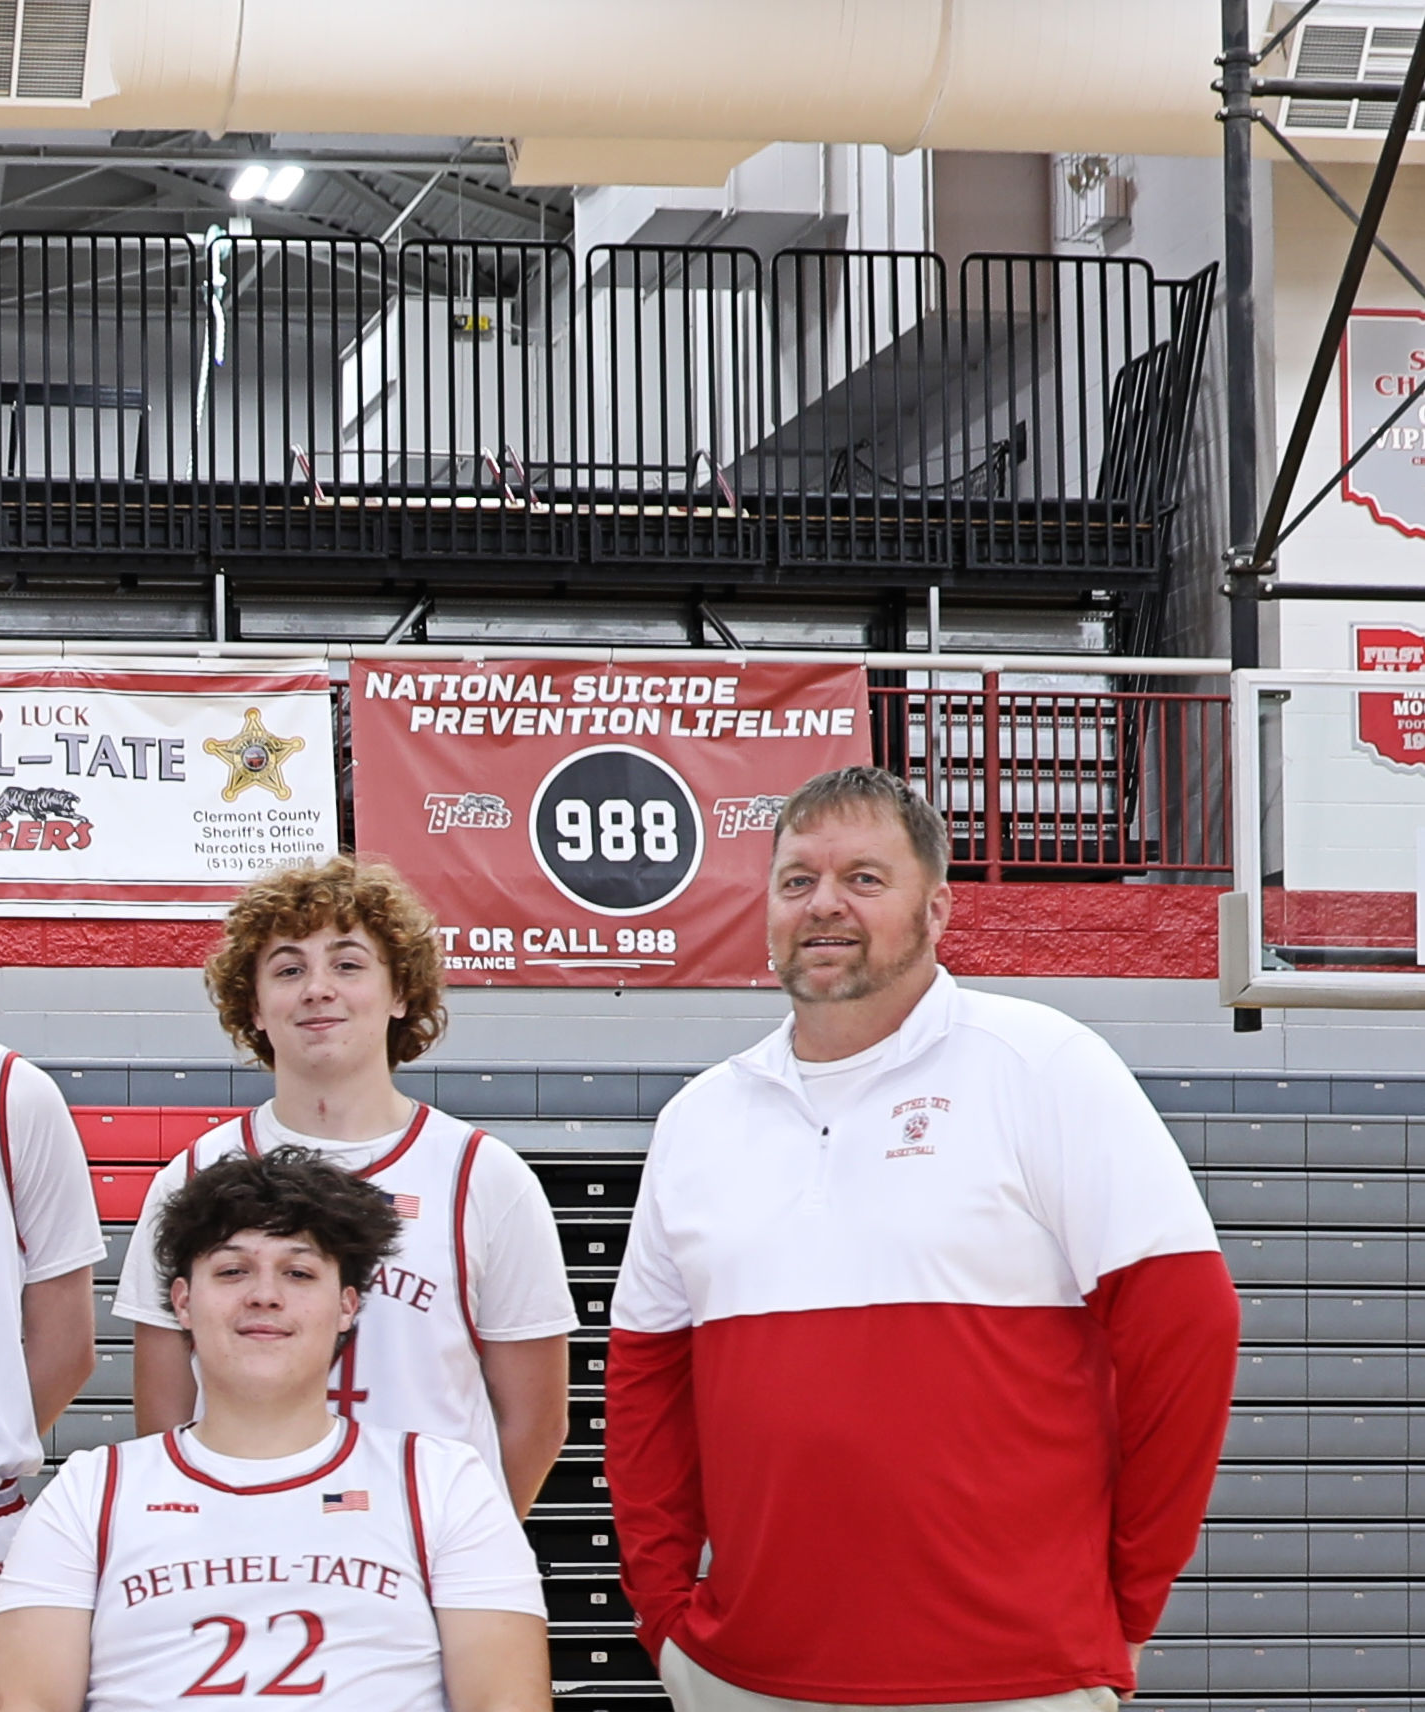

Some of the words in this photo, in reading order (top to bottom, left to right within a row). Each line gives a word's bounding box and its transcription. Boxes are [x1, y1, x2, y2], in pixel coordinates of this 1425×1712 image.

[365, 671, 561, 703] NATIONAL
[571, 675, 739, 705] SUICIDE
[21, 705, 90, 727] LUCK
[409, 706, 662, 737] PREVENTION
[670, 707, 856, 738] LIFELINE
[193, 810, 262, 823] Clermont
[267, 809, 321, 823] County
[424, 792, 512, 834] TIGERS
[713, 795, 777, 839] TIGE
[202, 826, 264, 839] Sheriff's
[269, 825, 314, 837] Office
[555, 799, 679, 862] 988
[195, 843, 266, 854] Narcotics
[271, 841, 325, 853] Hotline
[207, 858, 243, 871] (513)
[469, 928, 514, 952] OR
[522, 928, 609, 953] CALL
[616, 929, 677, 953] 988
[444, 957, 517, 971] ISTANCE
[120, 1554, 402, 1608] BETHEL-TATE
[177, 1609, 327, 1698] 22
